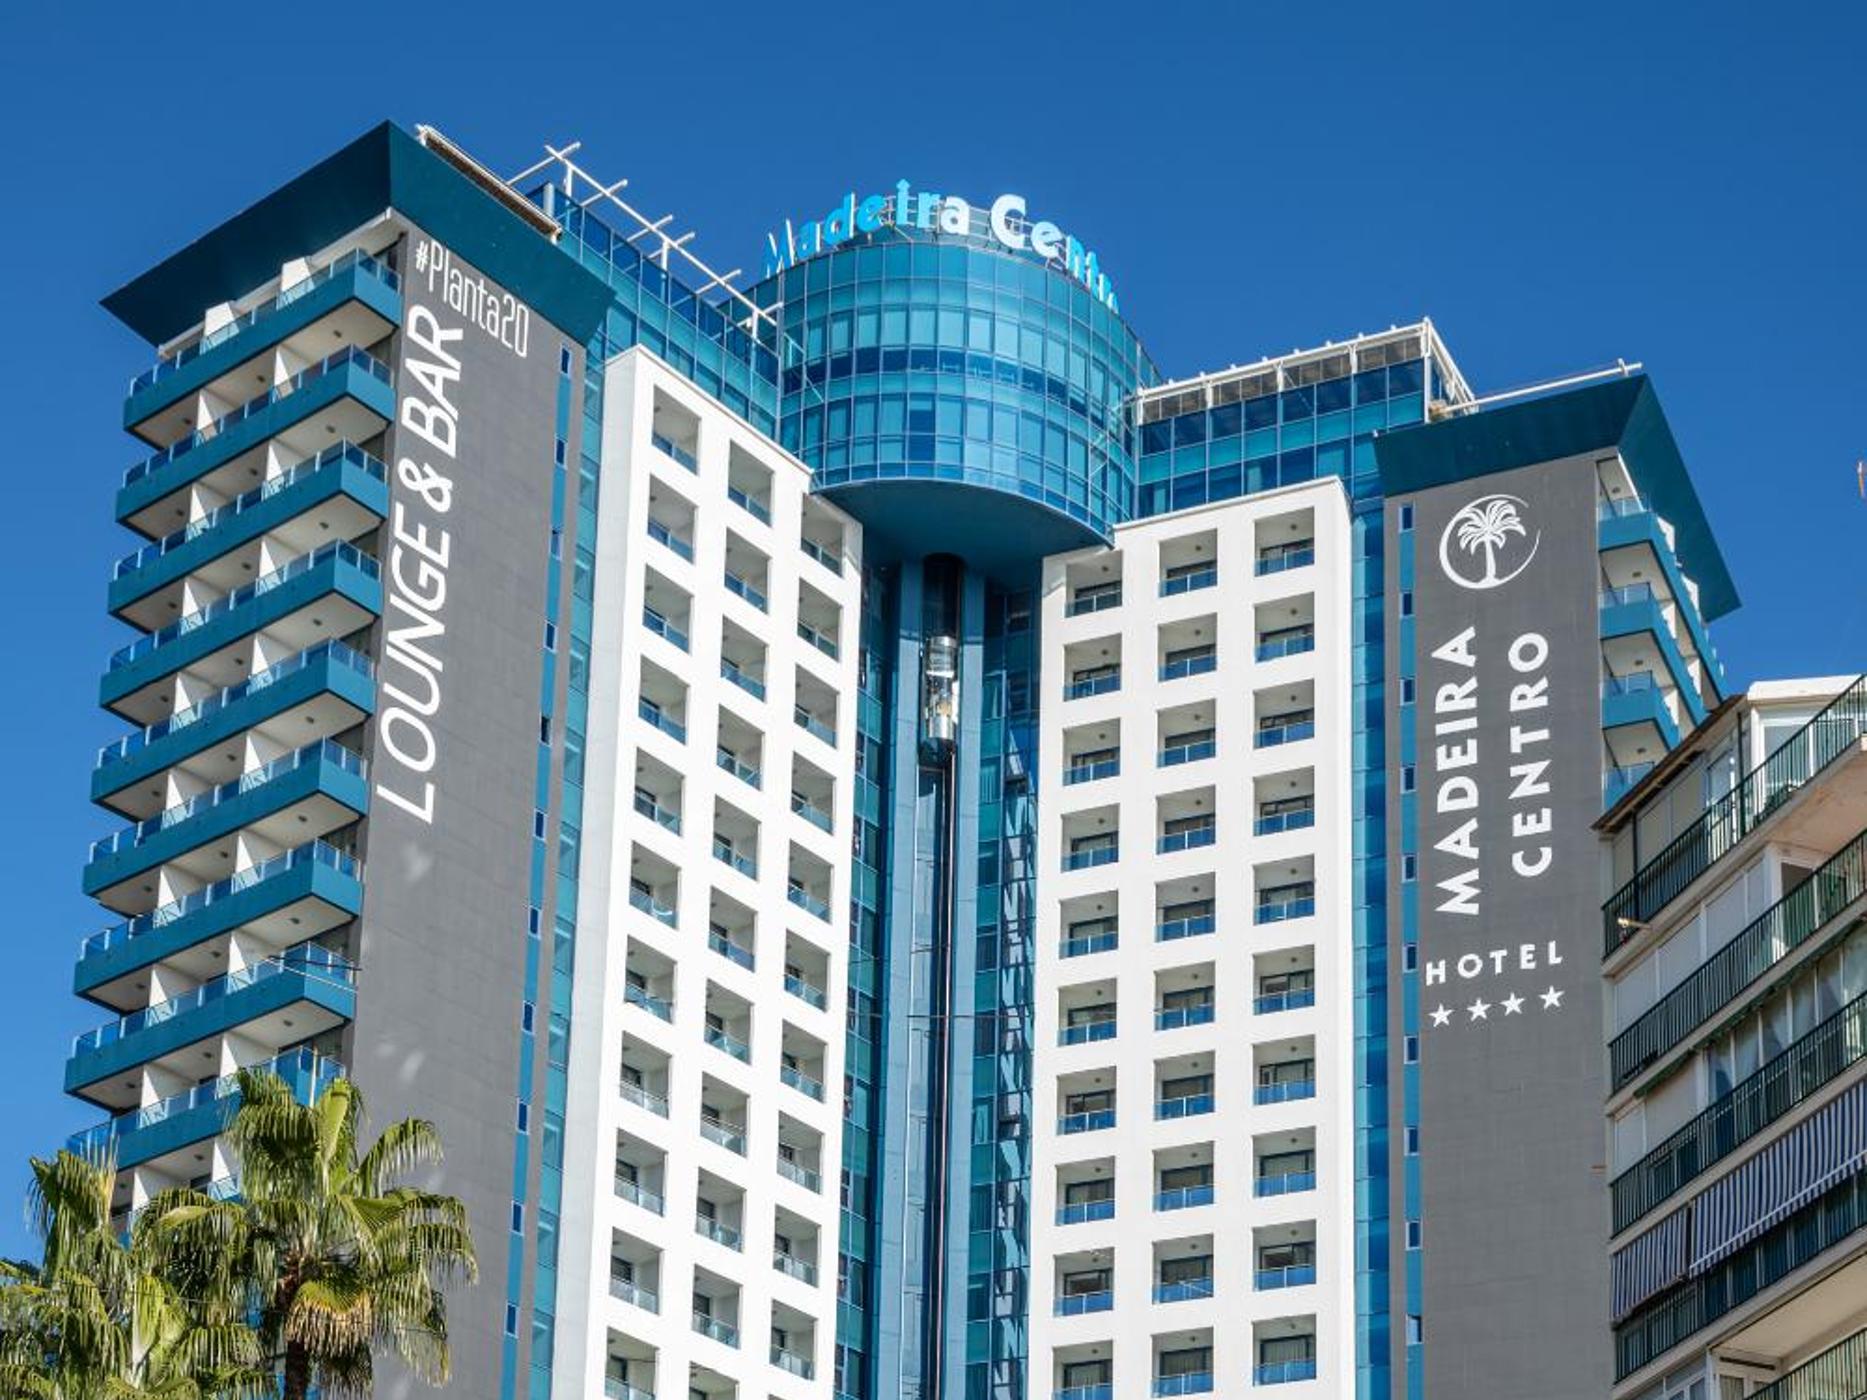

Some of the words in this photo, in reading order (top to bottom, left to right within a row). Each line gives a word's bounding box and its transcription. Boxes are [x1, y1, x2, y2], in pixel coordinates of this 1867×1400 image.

[763, 178, 970, 279] Madeira
[415, 240, 529, 358] #Planta20
[402, 303, 464, 459] BAR
[397, 457, 453, 514] &
[376, 502, 451, 825] LOUNGE
[1431, 625, 1482, 915] MADEIRA
[1507, 632, 1553, 877] CENTRO
[1426, 940, 1562, 985] HOTEL
